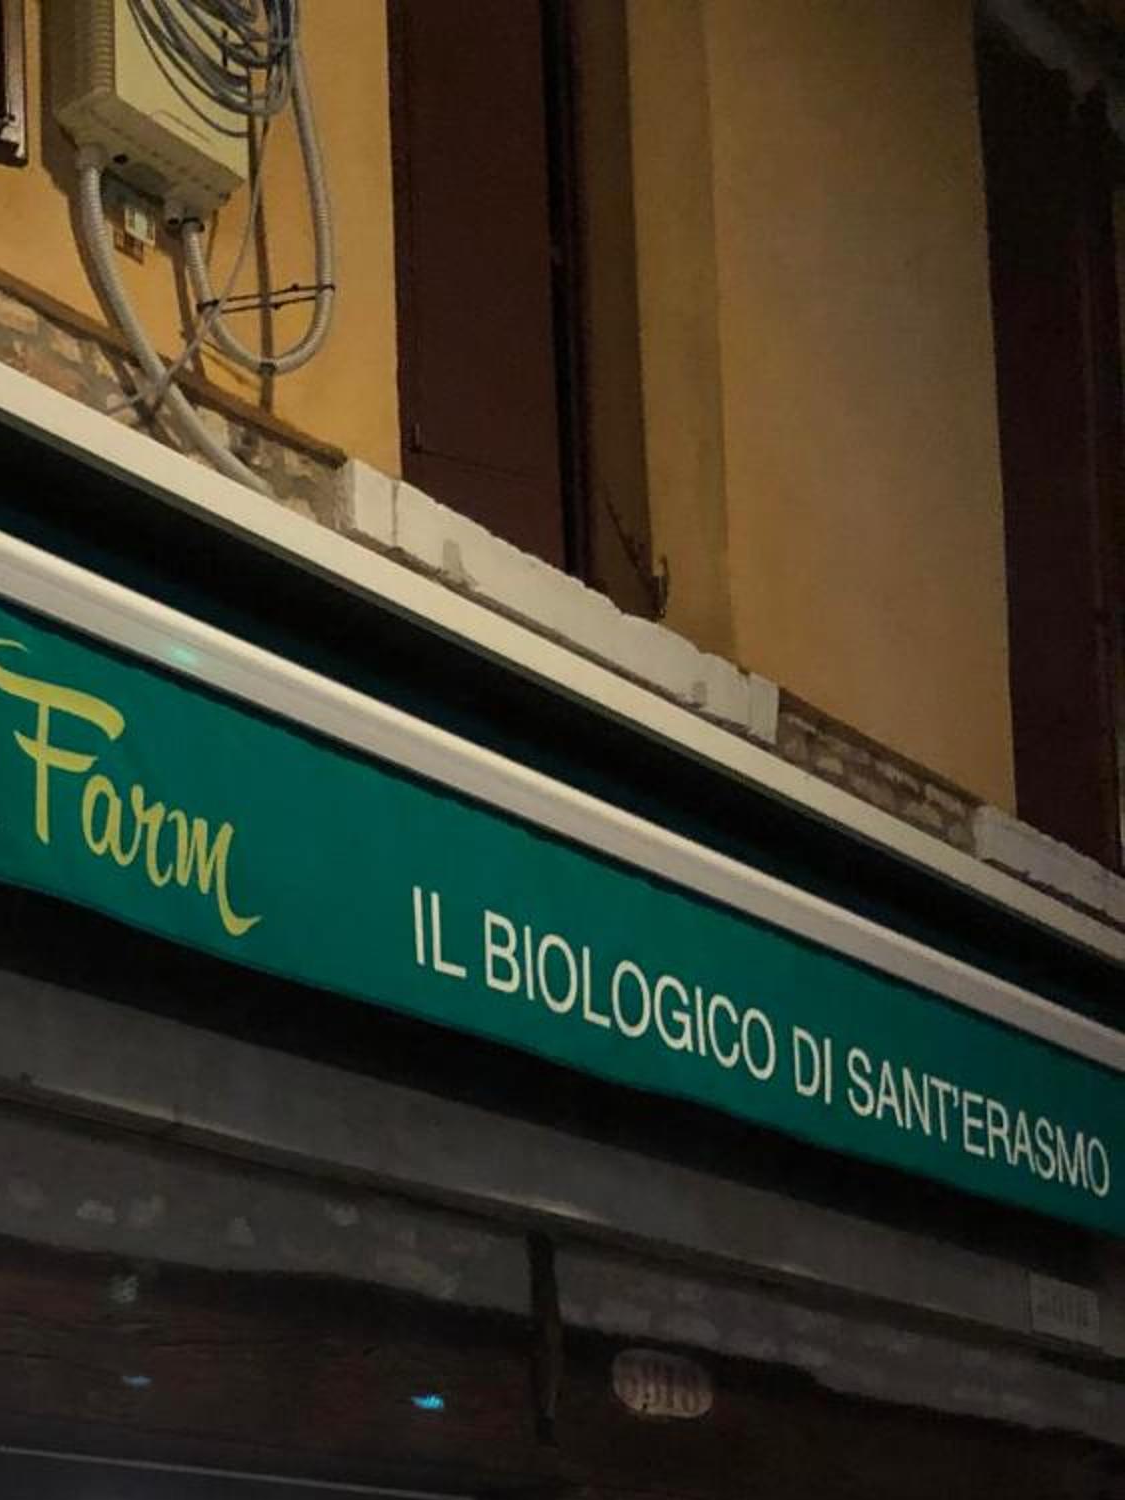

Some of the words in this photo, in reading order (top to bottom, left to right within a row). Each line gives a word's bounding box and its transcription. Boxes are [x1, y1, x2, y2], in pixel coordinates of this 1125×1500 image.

[412, 886, 467, 978] IL
[484, 909, 776, 1080] BIOLOGICO
[793, 1026, 832, 1104] DI
[846, 1046, 1111, 1198] SANT'ERASMO
